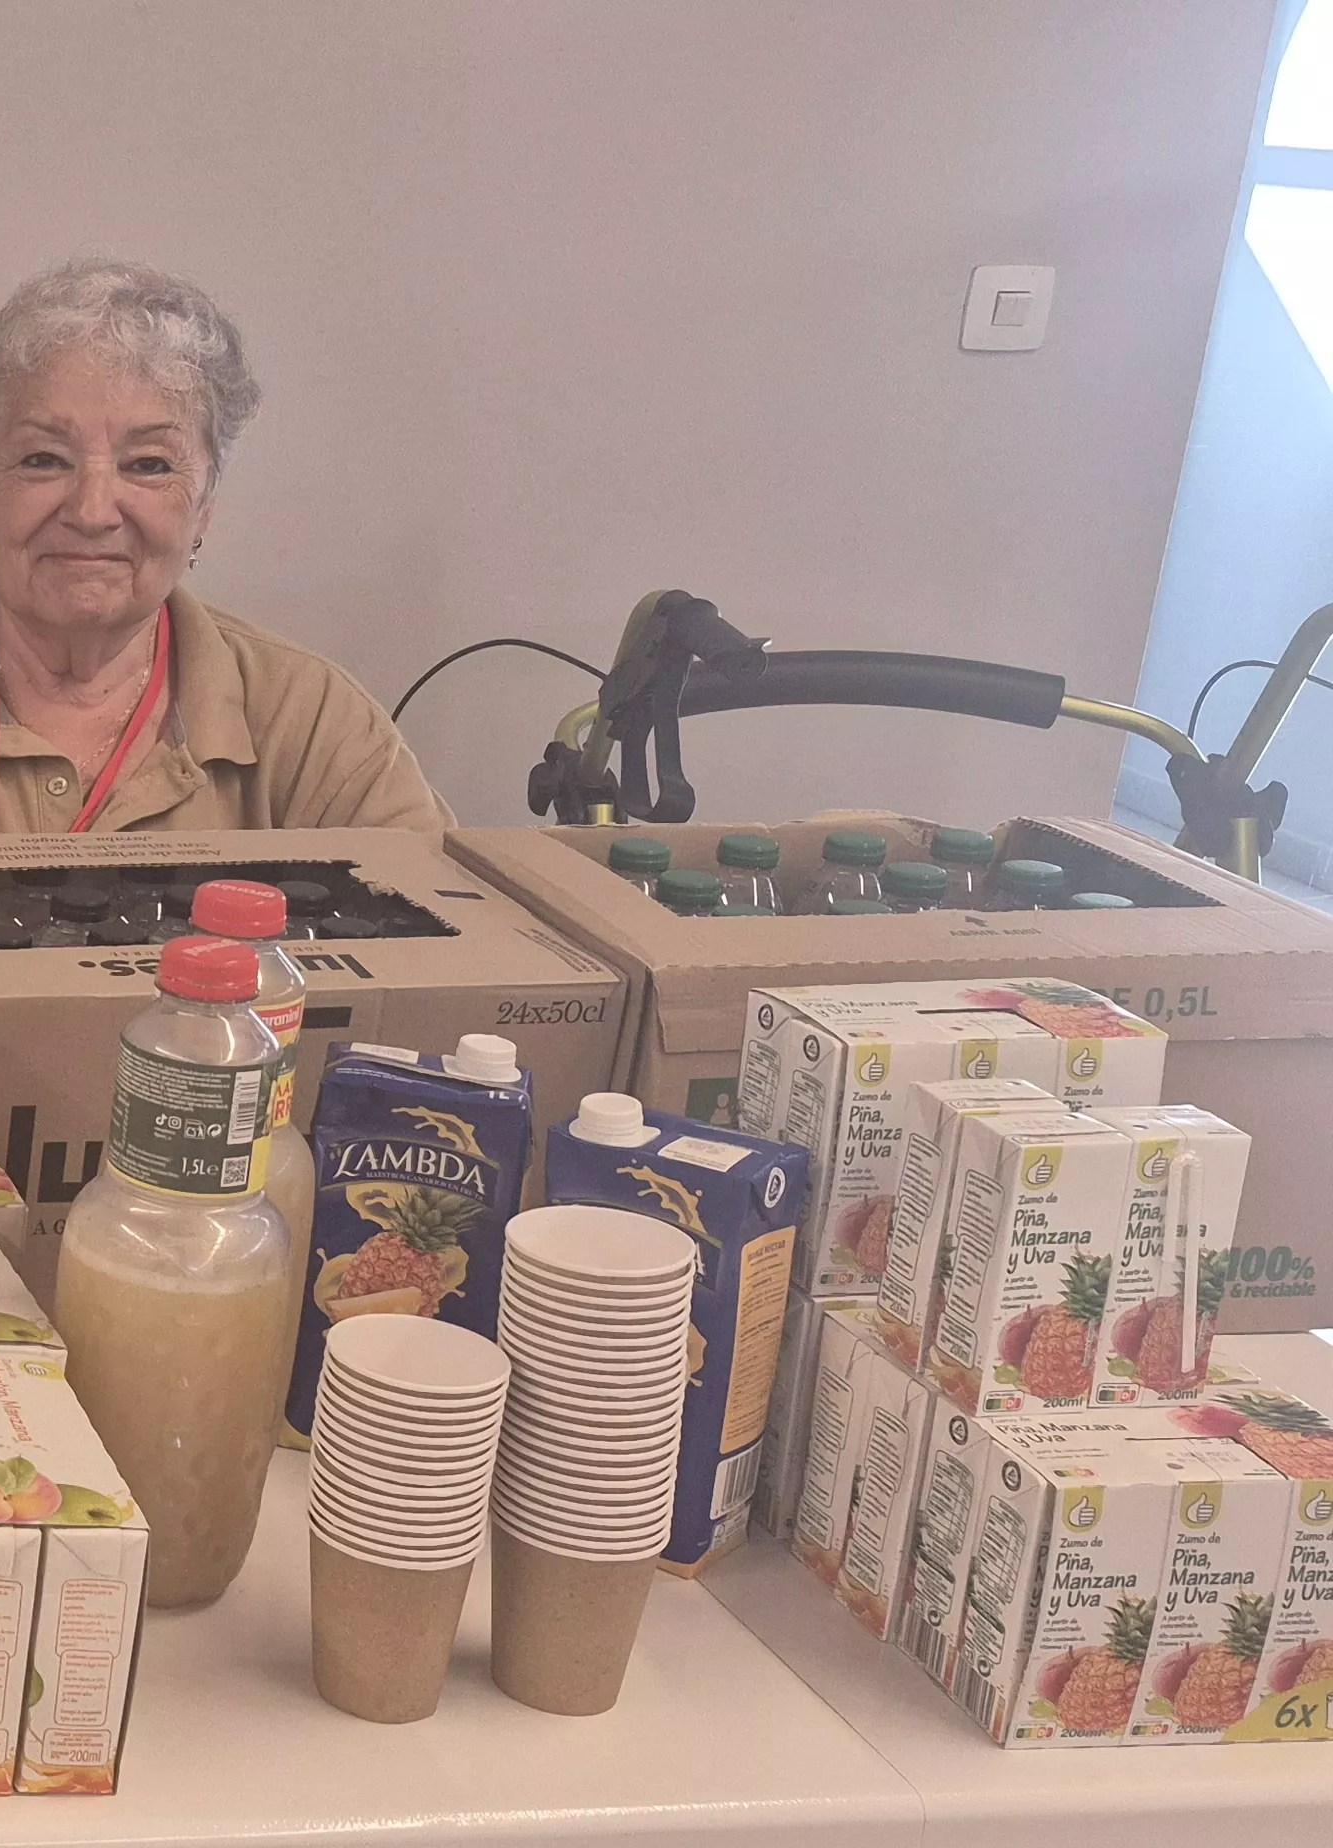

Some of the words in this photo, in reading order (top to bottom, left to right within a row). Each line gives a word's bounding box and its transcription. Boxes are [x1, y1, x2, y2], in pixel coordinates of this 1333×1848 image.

[495, 996, 607, 1026] 24x50cl
[1144, 985, 1219, 1022] 0,5L
[851, 1092, 879, 1103] Zumo
[880, 1090, 892, 1102] de
[1063, 1086, 1090, 1097] Zumo
[1091, 1086, 1103, 1096] de
[848, 1105, 884, 1125] Piña,
[846, 1123, 903, 1142] Manza
[843, 1146, 856, 1167] y
[859, 1141, 892, 1159] Uva
[181, 1156, 206, 1176] 1,5L
[332, 1142, 486, 1197] LAMBDA
[1017, 1194, 1045, 1205] Zumo
[1045, 1192, 1058, 1204] de
[1133, 1188, 1159, 1199] Zumo
[1159, 1187, 1169, 1198] d
[1014, 1208, 1049, 1230] Piña,
[1128, 1202, 1165, 1222] Piña,
[1010, 1229, 1093, 1249] Manzana
[1125, 1221, 1207, 1241] Manaa
[1006, 1253, 1020, 1275] y
[1023, 1247, 1056, 1265] Uva
[1120, 1245, 1133, 1267] y
[859, 1273, 883, 1285] 200
[1244, 1280, 1316, 1298] reciclable
[1042, 1395, 1084, 1409] 200ml
[1157, 1388, 1198, 1401] 200ml
[1, 1399, 33, 1443] Manzana
[996, 1423, 1042, 1436] Piña,
[1041, 1421, 1129, 1434] Manzana
[1012, 1436, 1031, 1449] y
[1030, 1432, 1067, 1444] Uva
[1059, 1537, 1088, 1548] Zumo
[1090, 1536, 1103, 1548] de
[1176, 1533, 1207, 1545] Zumo
[1208, 1532, 1221, 1544] de
[1295, 1530, 1325, 1542] Zumo
[1055, 1552, 1094, 1573] Piña,
[1172, 1548, 1212, 1570] Piña,
[1290, 1545, 1331, 1567] Piña,
[1052, 1571, 1138, 1590] Manzana
[1169, 1568, 1255, 1586] Manzana
[1286, 1565, 1333, 1584] Manz
[1047, 1597, 1061, 1618] y
[1066, 1591, 1101, 1609] Uva
[1164, 1593, 1179, 1613] y
[1183, 1587, 1219, 1605] Uva
[1281, 1588, 1296, 1609] y
[1301, 1585, 1333, 1602] Uva
[1275, 1694, 1319, 1730] 6x
[68, 1749, 102, 1763] 200ml
